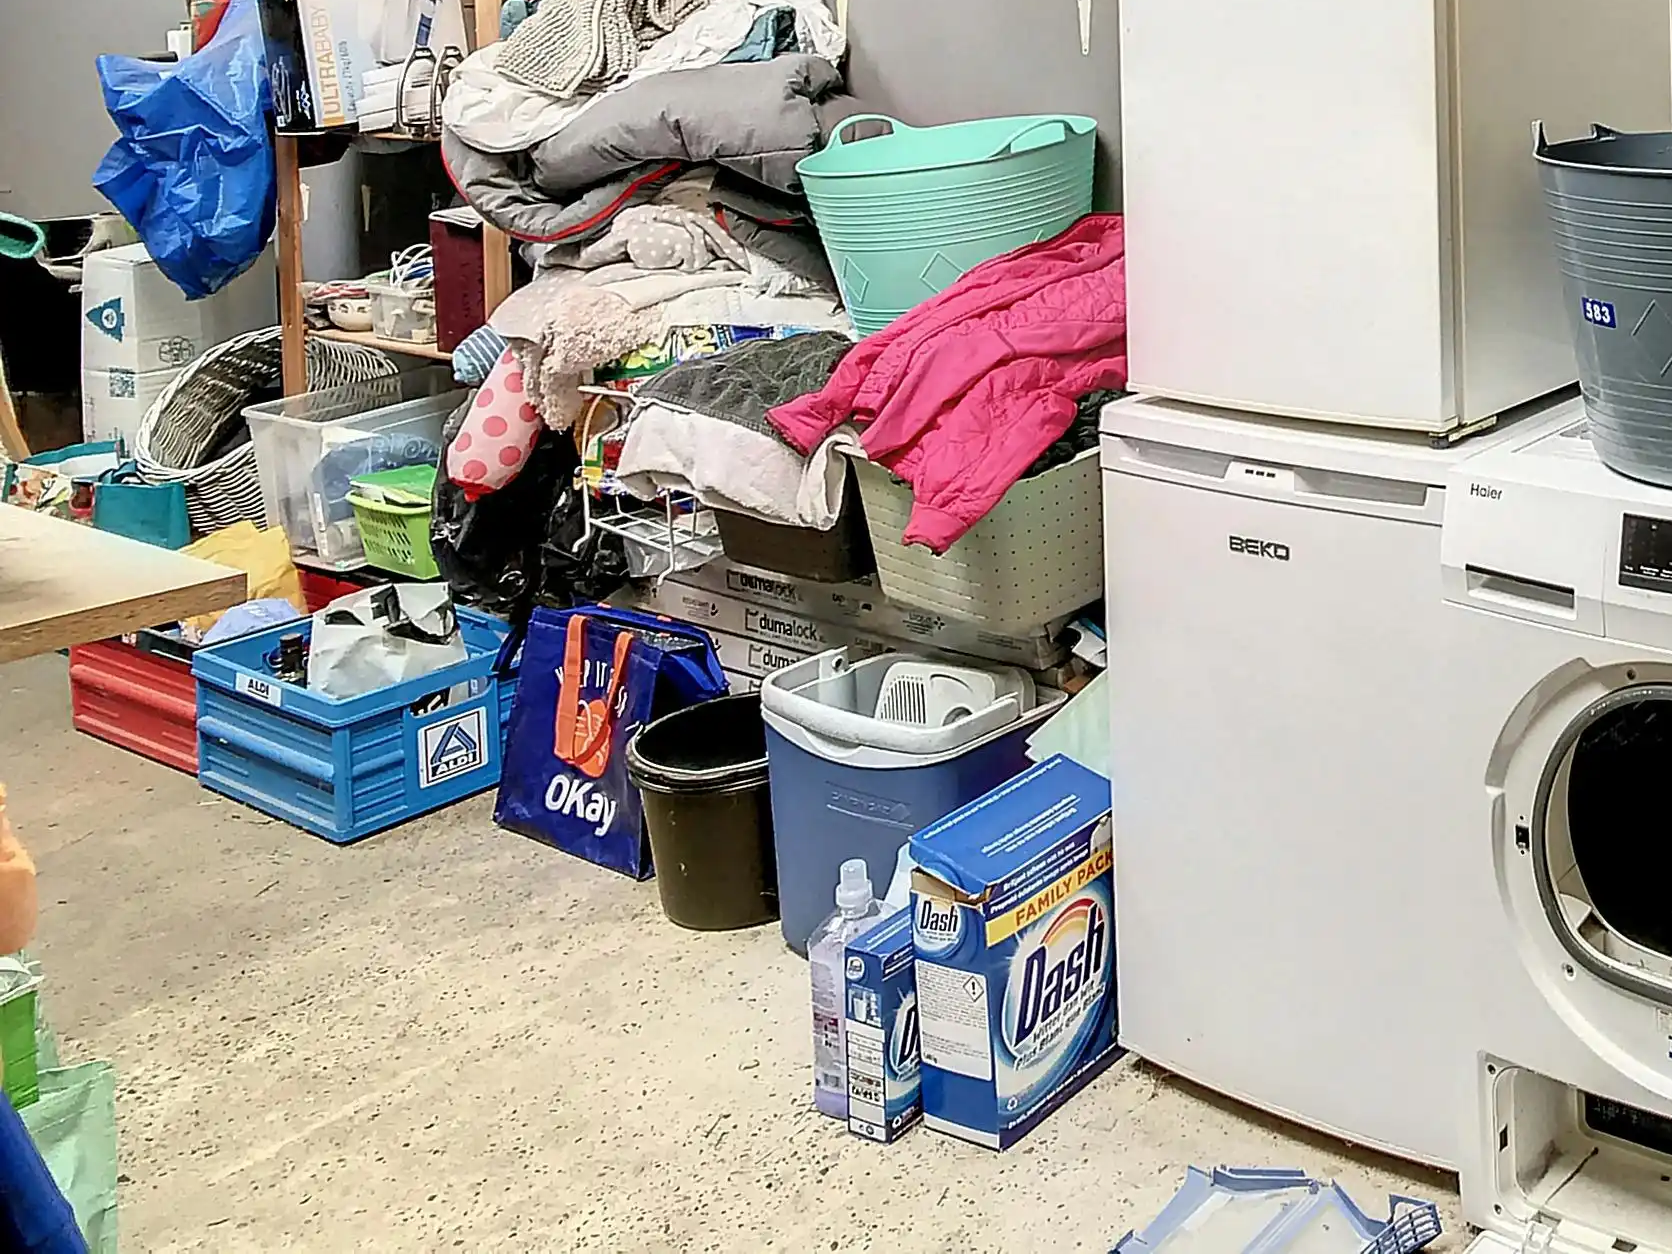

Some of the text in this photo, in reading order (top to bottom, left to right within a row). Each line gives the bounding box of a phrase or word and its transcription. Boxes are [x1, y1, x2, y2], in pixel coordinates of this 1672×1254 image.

[310, 0, 342, 115] ULTRABABY
[1585, 301, 1611, 324] 583
[1469, 482, 1504, 501] Haier
[1228, 535, 1290, 561] BEKO
[759, 612, 818, 642] dumalock
[247, 678, 270, 696] ALDI
[595, 660, 608, 688] IT
[435, 752, 475, 776] ALDI
[544, 774, 617, 837] OKay
[1014, 848, 1114, 927] FAMILY PACK
[919, 900, 959, 933] Dash
[1014, 902, 1105, 1047] Dash
